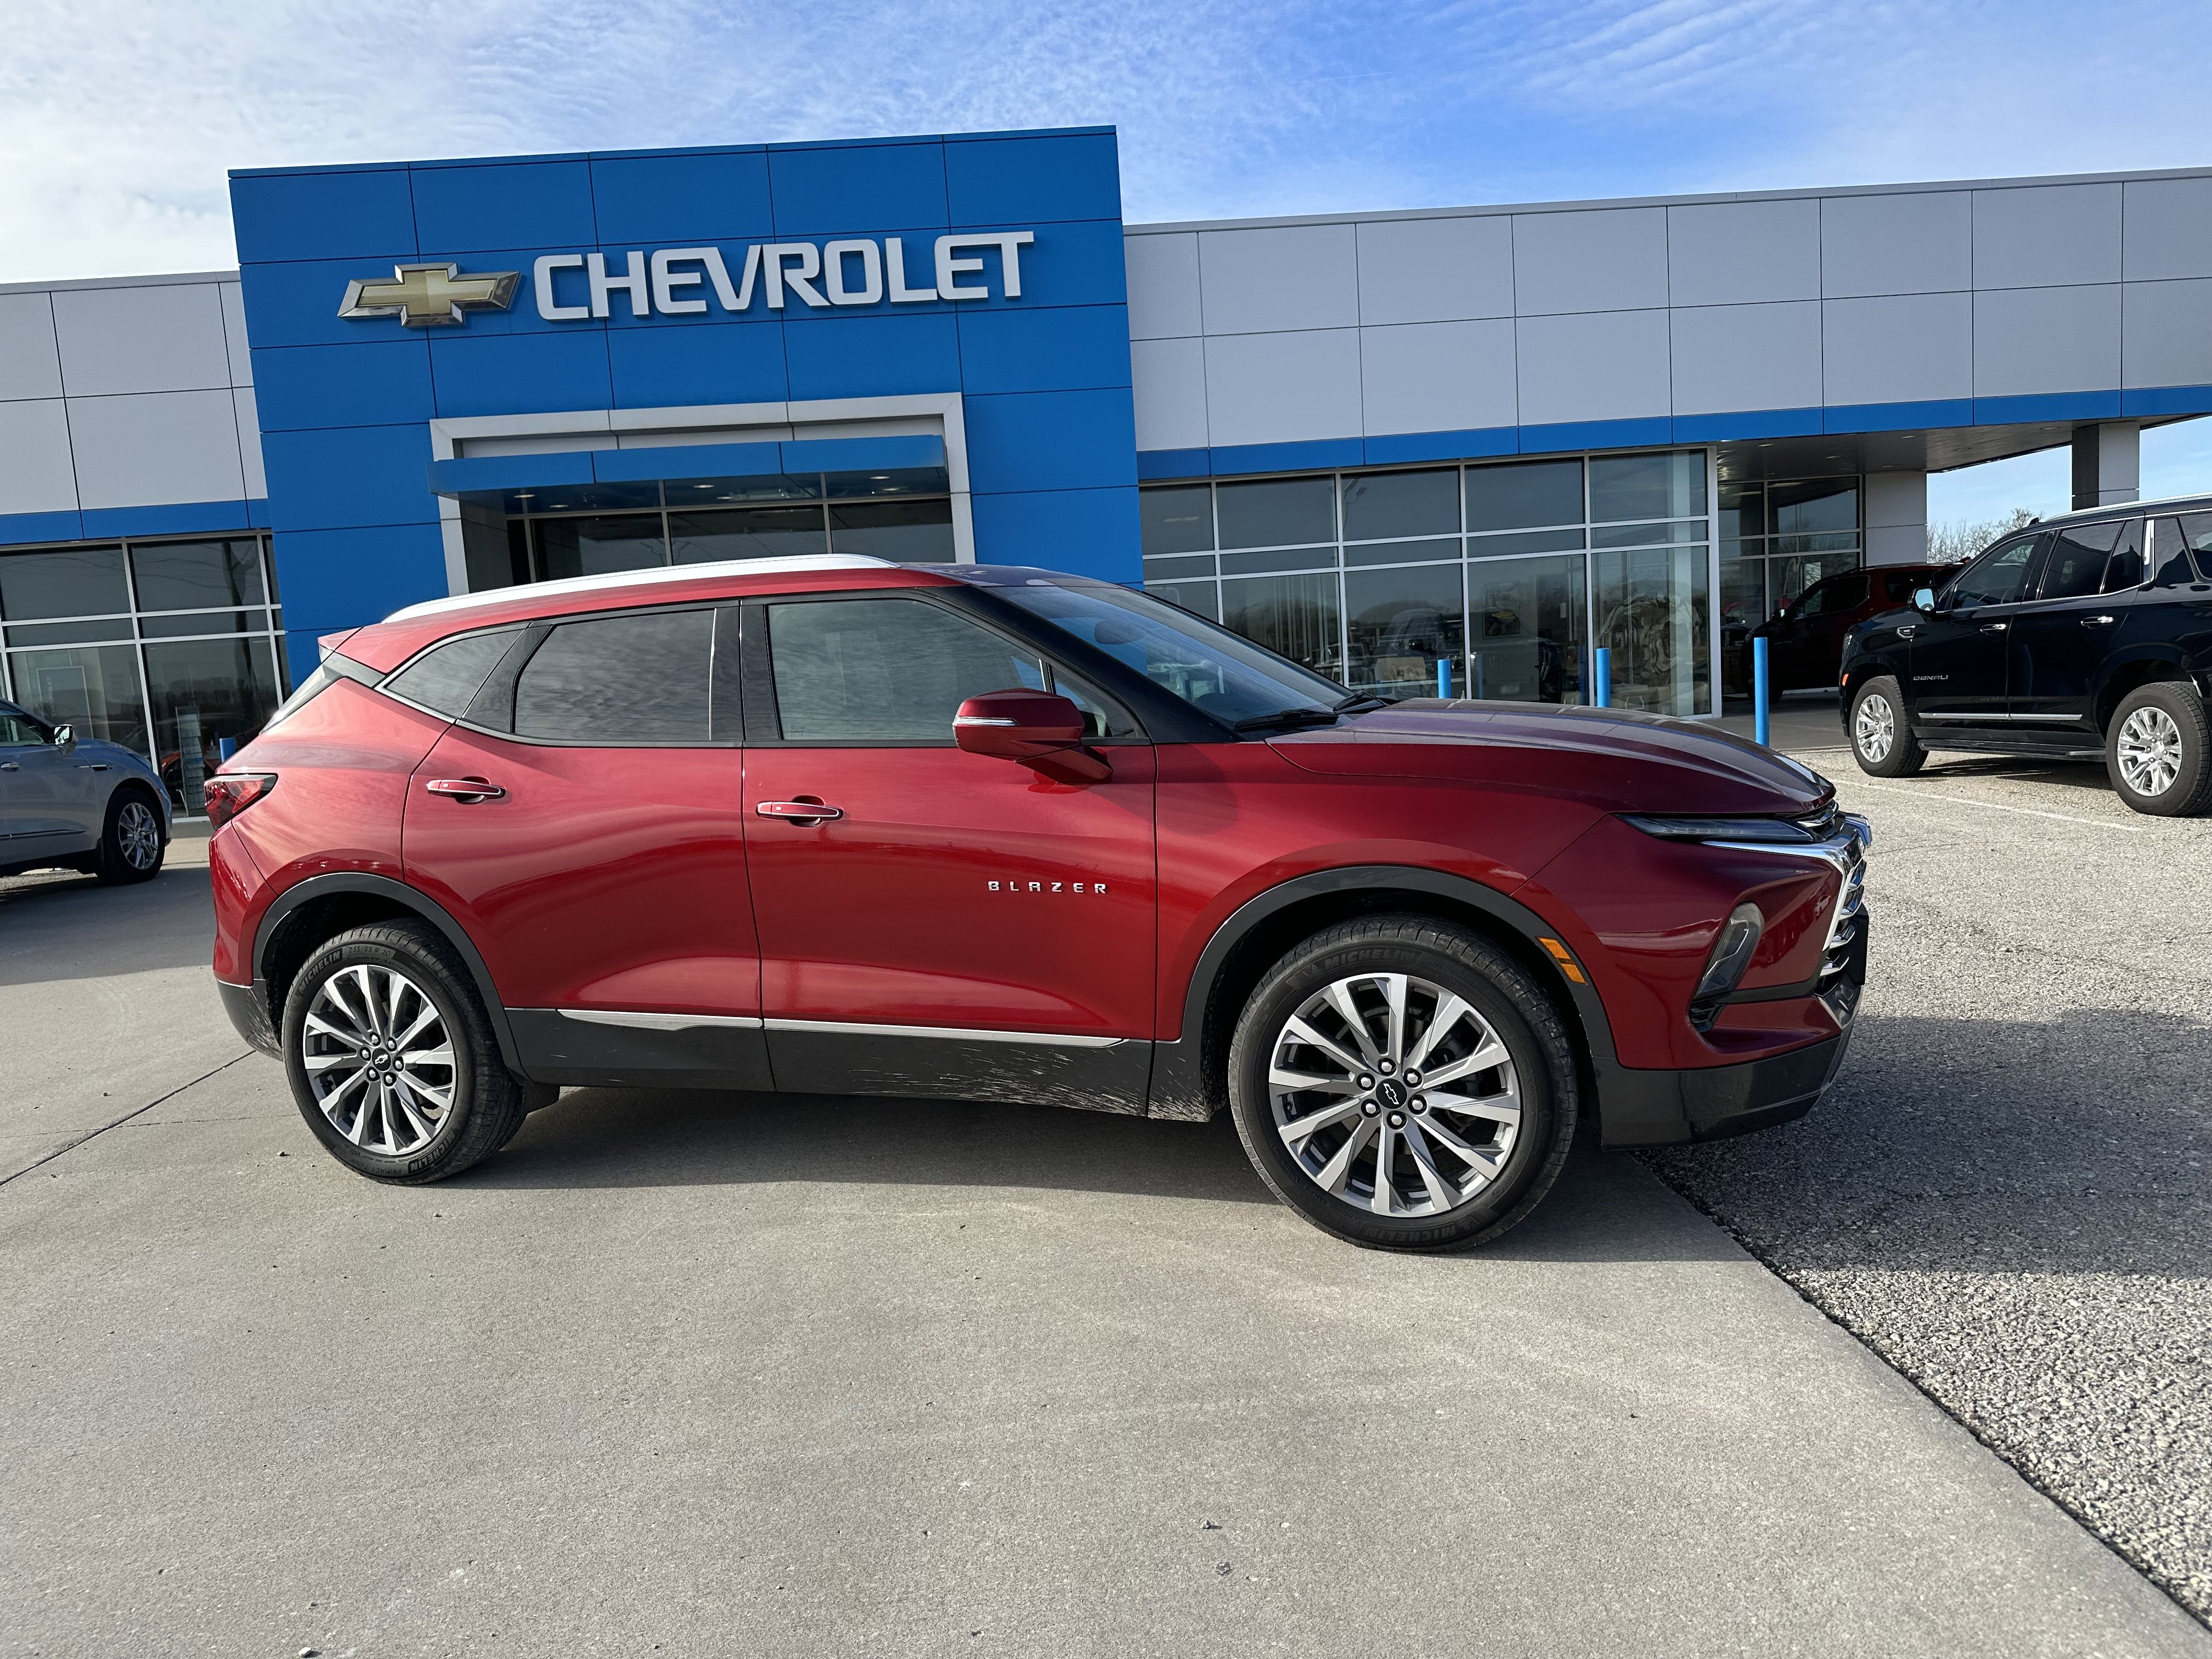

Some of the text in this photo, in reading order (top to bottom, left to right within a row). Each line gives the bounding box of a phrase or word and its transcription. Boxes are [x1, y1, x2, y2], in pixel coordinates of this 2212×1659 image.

[533, 230, 1035, 321] CHEVROLET
[988, 881, 1106, 894] BLAZER
[1324, 949, 1415, 970] MICHELIN
[298, 950, 341, 995] MICHELIN
[409, 1128, 456, 1173] MICHELIN
[349, 1158, 402, 1175] PRIMACY TOUR
[1363, 1222, 1456, 1243] MICHELIN
